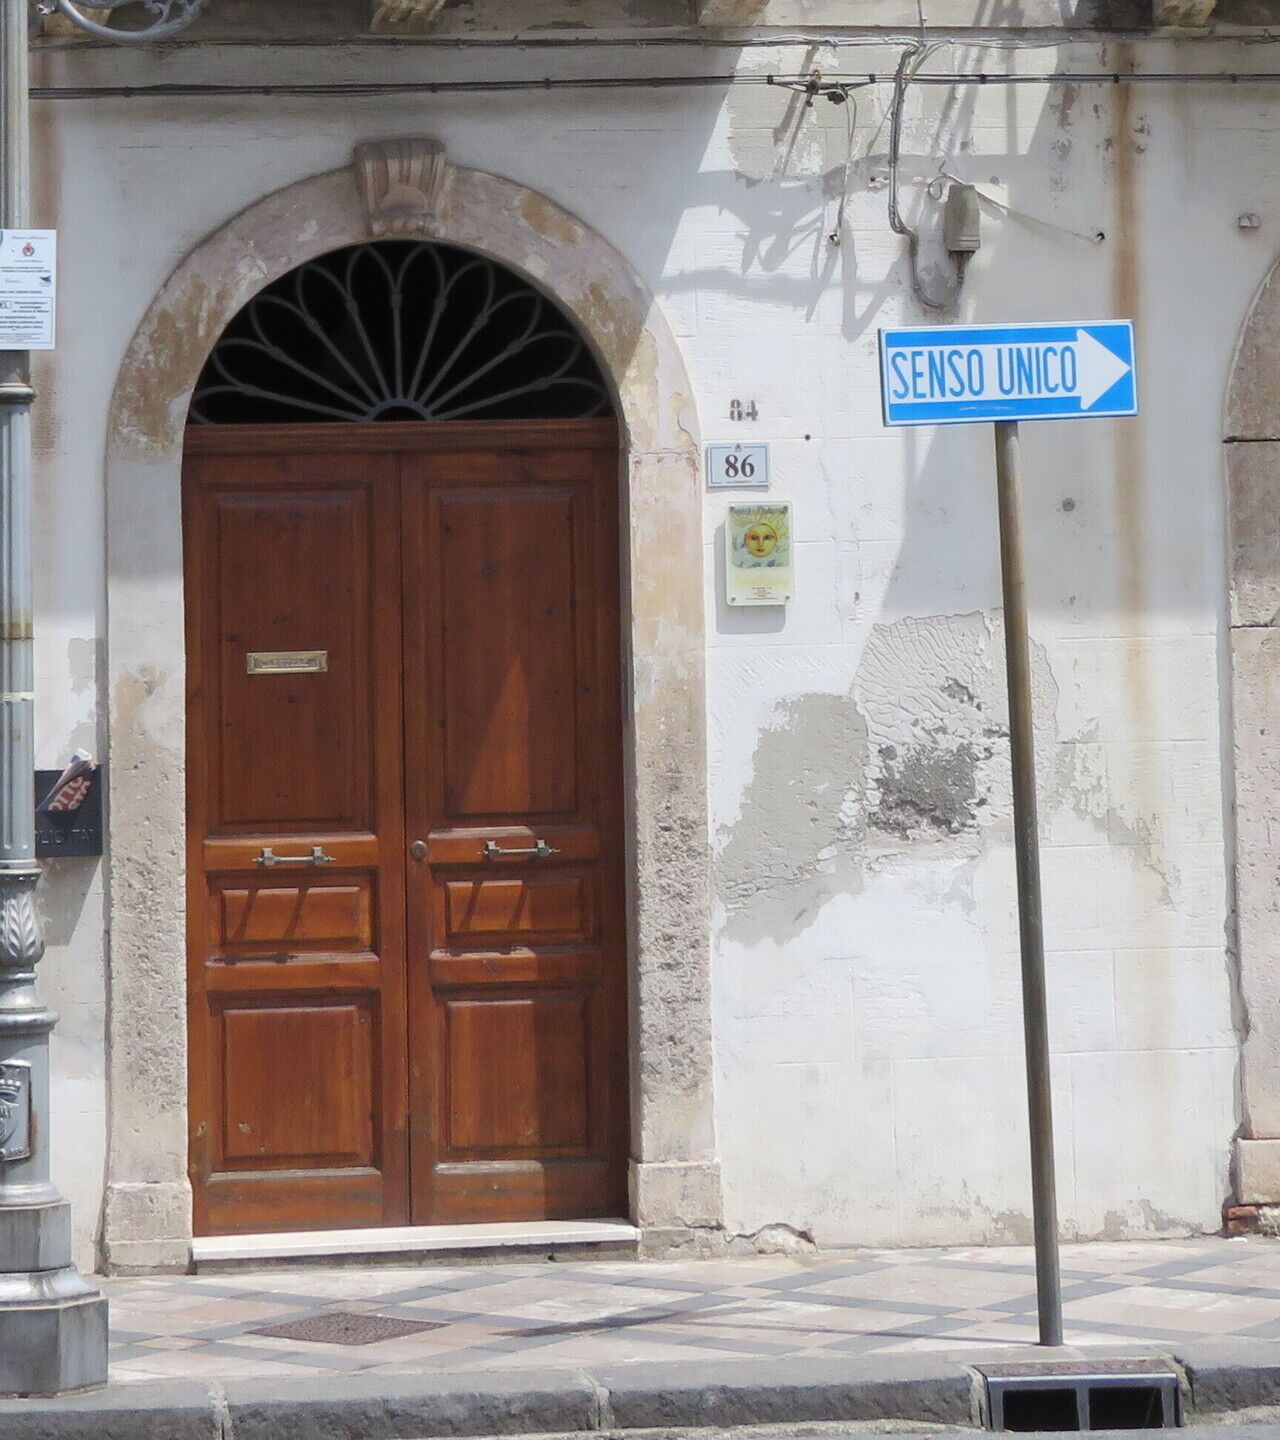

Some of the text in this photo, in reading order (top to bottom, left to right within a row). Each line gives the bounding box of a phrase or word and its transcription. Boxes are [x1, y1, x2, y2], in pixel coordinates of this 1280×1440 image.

[891, 345, 1077, 399] SENSO UNICO
[730, 399, 759, 421] 84
[725, 454, 756, 478] 86
